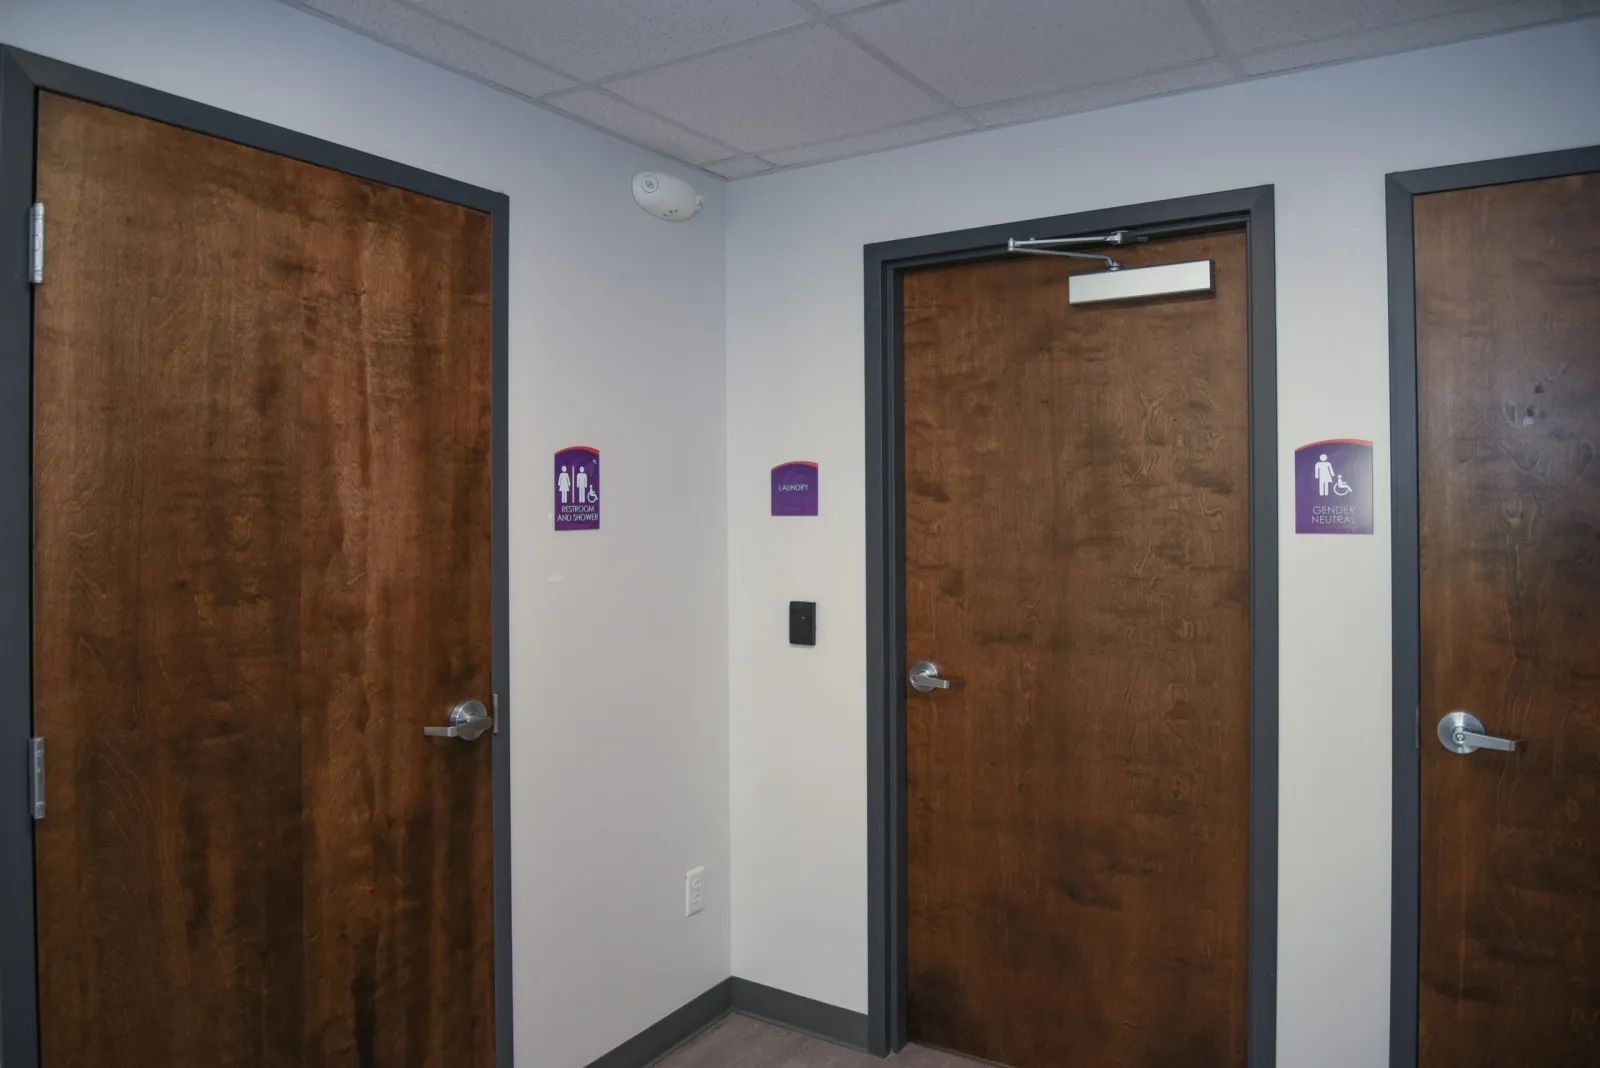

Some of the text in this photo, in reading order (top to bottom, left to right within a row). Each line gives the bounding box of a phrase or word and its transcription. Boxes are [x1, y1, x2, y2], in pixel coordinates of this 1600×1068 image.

[561, 505, 595, 513] RESTROOM
[1312, 505, 1356, 514] GENDER
[1311, 515, 1356, 524] NEUTRAL
